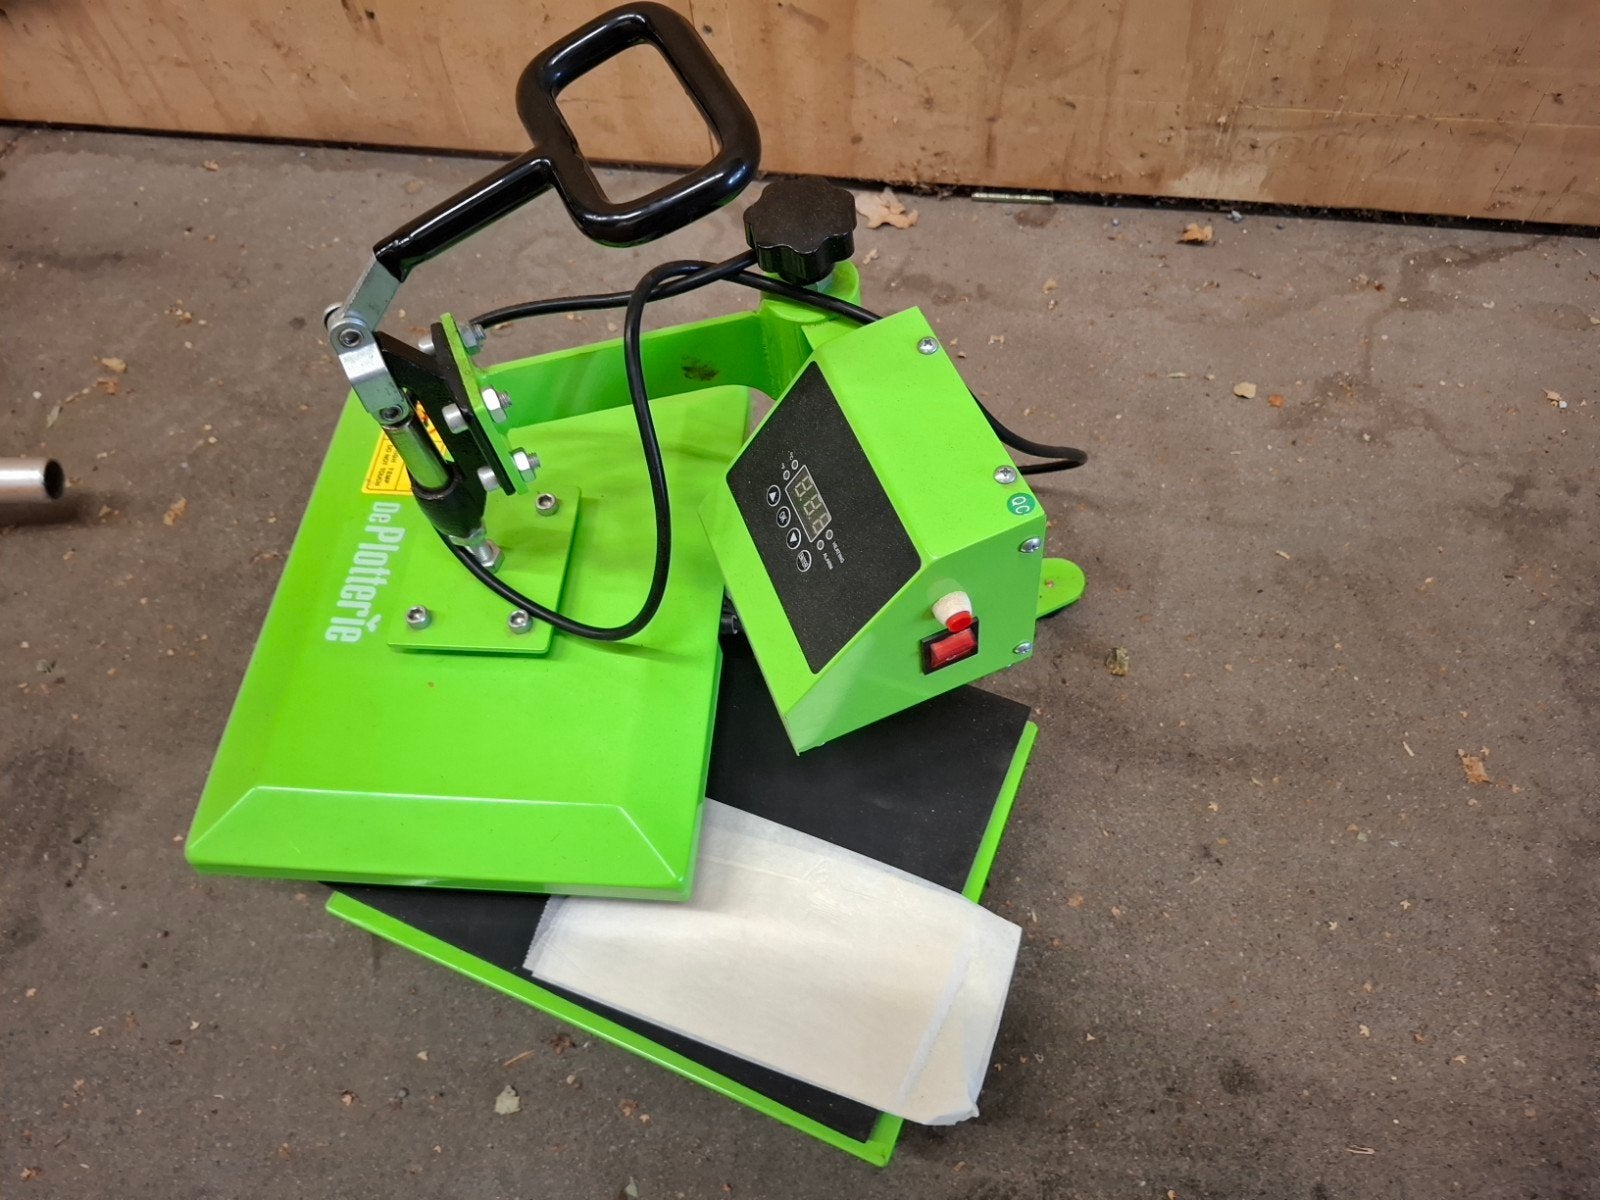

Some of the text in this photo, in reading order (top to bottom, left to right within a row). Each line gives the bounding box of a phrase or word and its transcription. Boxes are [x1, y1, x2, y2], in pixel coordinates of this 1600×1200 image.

[387, 445, 393, 453] DO
[375, 467, 386, 486] TOUCH
[384, 468, 394, 484] TEMP
[1011, 496, 1030, 514] QC
[799, 552, 809, 569] ENTER
[823, 552, 834, 570] ALARM
[832, 541, 845, 564] HEATING
